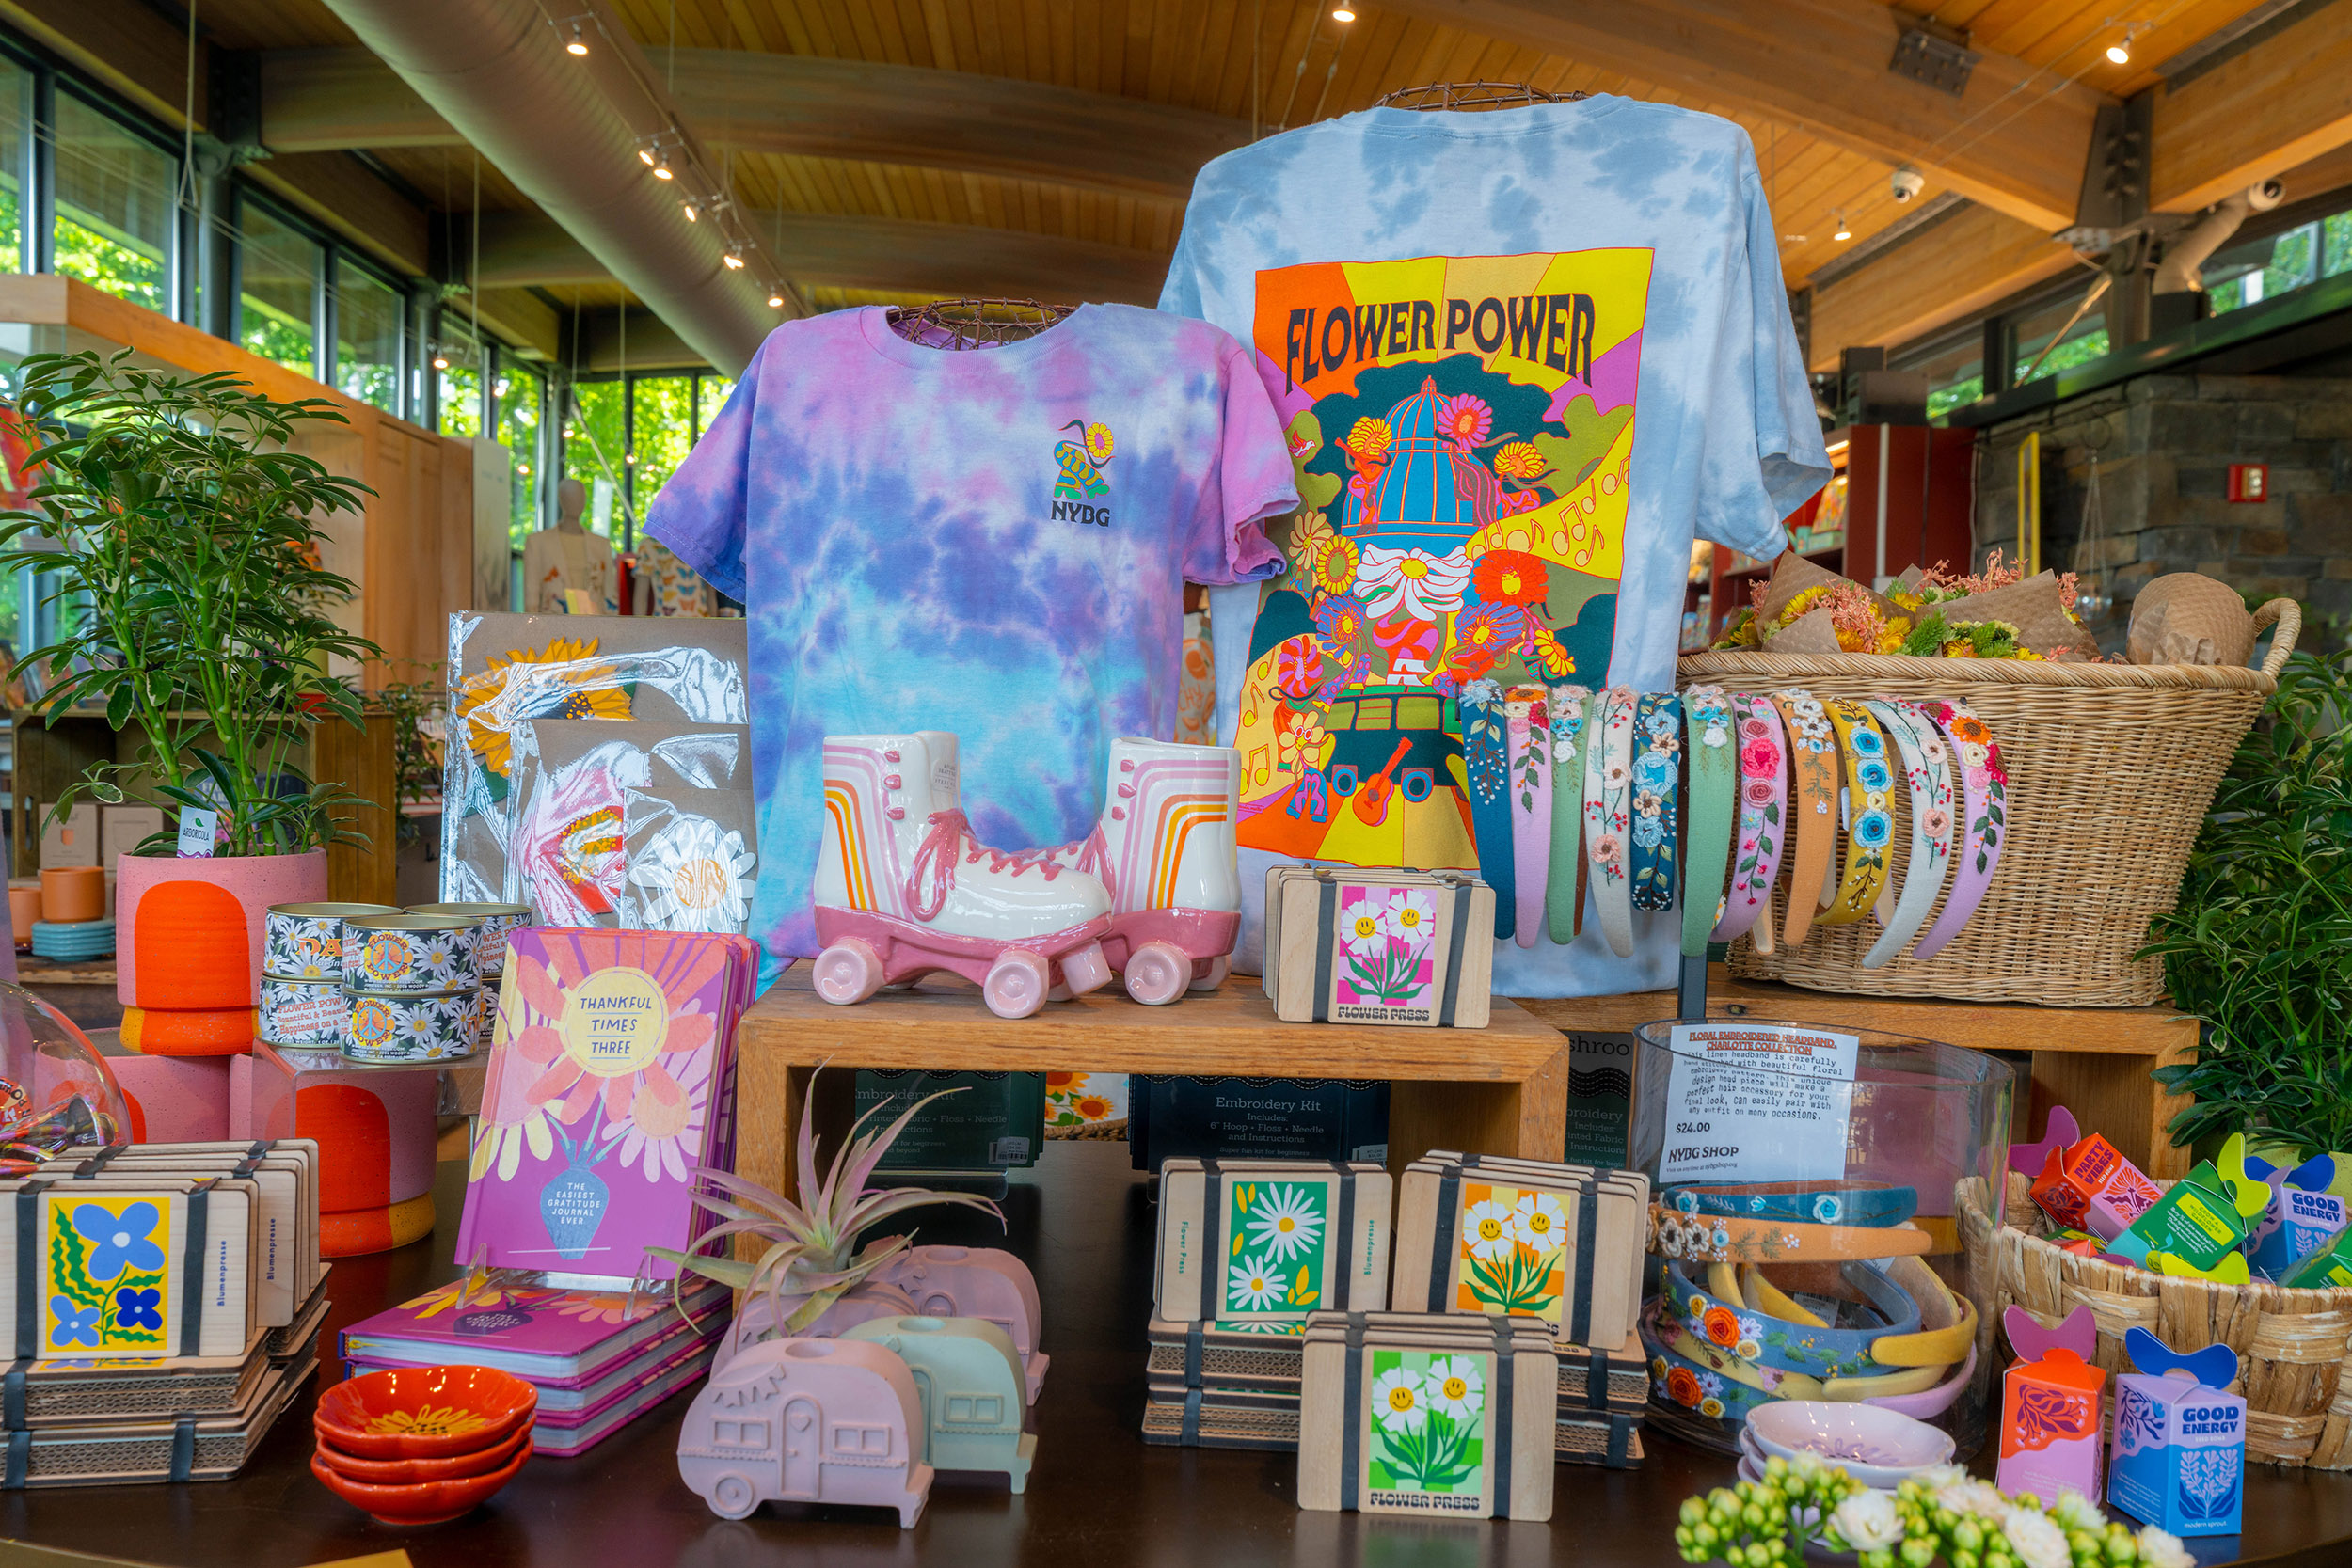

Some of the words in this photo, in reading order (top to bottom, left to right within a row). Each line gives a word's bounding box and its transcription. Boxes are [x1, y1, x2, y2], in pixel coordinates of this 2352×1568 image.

[1285, 299, 1437, 398] FLOWER
[1443, 293, 1596, 388] POWER
[1051, 500, 1110, 527] NYBG
[183, 828, 210, 841] ARBORICOLA
[367, 933, 408, 950] FLOWER
[367, 963, 408, 980] POWER
[278, 1000, 316, 1014] FLOWER
[356, 999, 390, 1017] FLOWER
[580, 996, 652, 1009] THANKFUL
[278, 1010, 313, 1023] Bountiful
[1338, 1006, 1389, 1020] FLOWER
[1391, 1008, 1430, 1022] PRESS
[279, 1022, 320, 1037] Happiness
[321, 1021, 330, 1029] on
[591, 1018, 638, 1032] TIMES
[354, 1029, 390, 1046] POWER
[1689, 1032, 1717, 1041] FLORAL
[1719, 1031, 1781, 1042] EMBROIDERED
[592, 1040, 631, 1054] THREE
[1707, 1041, 1754, 1051] CHARLOTTE
[1755, 1042, 1812, 1055] COLLECTION
[1731, 1051, 1770, 1059] headband
[1789, 1055, 1836, 1068] carefully
[1737, 1059, 1756, 1068] with
[1761, 1060, 1806, 1070] beautiful
[1813, 1066, 1843, 1075] floral
[1692, 1075, 1716, 1085] design
[1741, 1076, 1765, 1085] piece
[1770, 1081, 1789, 1089] will
[1795, 1083, 1816, 1091] make
[1801, 1075, 1832, 1085] unique
[1687, 1085, 1714, 1097] perfect
[1719, 1084, 1737, 1092] hair
[1740, 1086, 1784, 1098] accessory
[1809, 1093, 1830, 1101] your
[1216, 1096, 1296, 1113] Embroidery
[1300, 1100, 1322, 1112] Kit
[1684, 1097, 1703, 1106] final
[1707, 1094, 1728, 1106] look,
[1733, 1096, 1747, 1105] can
[1752, 1097, 1781, 1106] easily
[1785, 1099, 1806, 1109] pair
[1810, 1101, 1832, 1110] with
[941, 1115, 964, 1123] Floss
[975, 1115, 1008, 1123] Needle
[1248, 1113, 1289, 1122] Includes:
[1748, 1108, 1767, 1117] many
[1772, 1109, 1821, 1120] occasions.
[1223, 1122, 1248, 1132] Hoop
[1258, 1124, 1281, 1132] Floss
[1292, 1125, 1324, 1134] Needle
[1575, 1121, 1615, 1132] Includes:
[1676, 1122, 1710, 1133] $24.00
[1248, 1133, 1305, 1144] Instructions
[1595, 1133, 1624, 1144] Fabric
[1219, 1147, 1235, 1155] Super
[1277, 1148, 1310, 1157] beginners
[1668, 1147, 1700, 1164] NYBG
[1702, 1147, 1740, 1158] SHOP
[2074, 1140, 2105, 1179] PARTY
[1594, 1158, 1604, 1166] for
[2083, 1148, 2115, 1185] VIBES
[567, 1182, 586, 1191] THE
[556, 1191, 595, 1199] EASIEST
[2292, 1193, 2340, 1212] GOOD
[548, 1199, 600, 1208] GRATITUDE
[551, 1208, 594, 1216] JOURNAL
[2169, 1207, 2181, 1217] Bury
[2189, 1204, 2221, 1234] WILDFLOWER
[2199, 1207, 2215, 1221] GROW
[2293, 1204, 2341, 1223] ENERGY
[561, 1216, 584, 1225] EVER
[2191, 1213, 2212, 1232] GARDEN
[1181, 1221, 1189, 1249] Flower
[266, 1218, 277, 1280] Blumenpresse
[1363, 1219, 1375, 1275] Blumenpresse
[1179, 1252, 1187, 1275] Press
[216, 1241, 228, 1307] Blumenpresse
[2183, 1406, 2239, 1422] GOOD
[2183, 1421, 2238, 1434] ENERGY
[1370, 1493, 1430, 1508] FLOWER
[1433, 1496, 1480, 1511] PRESS
